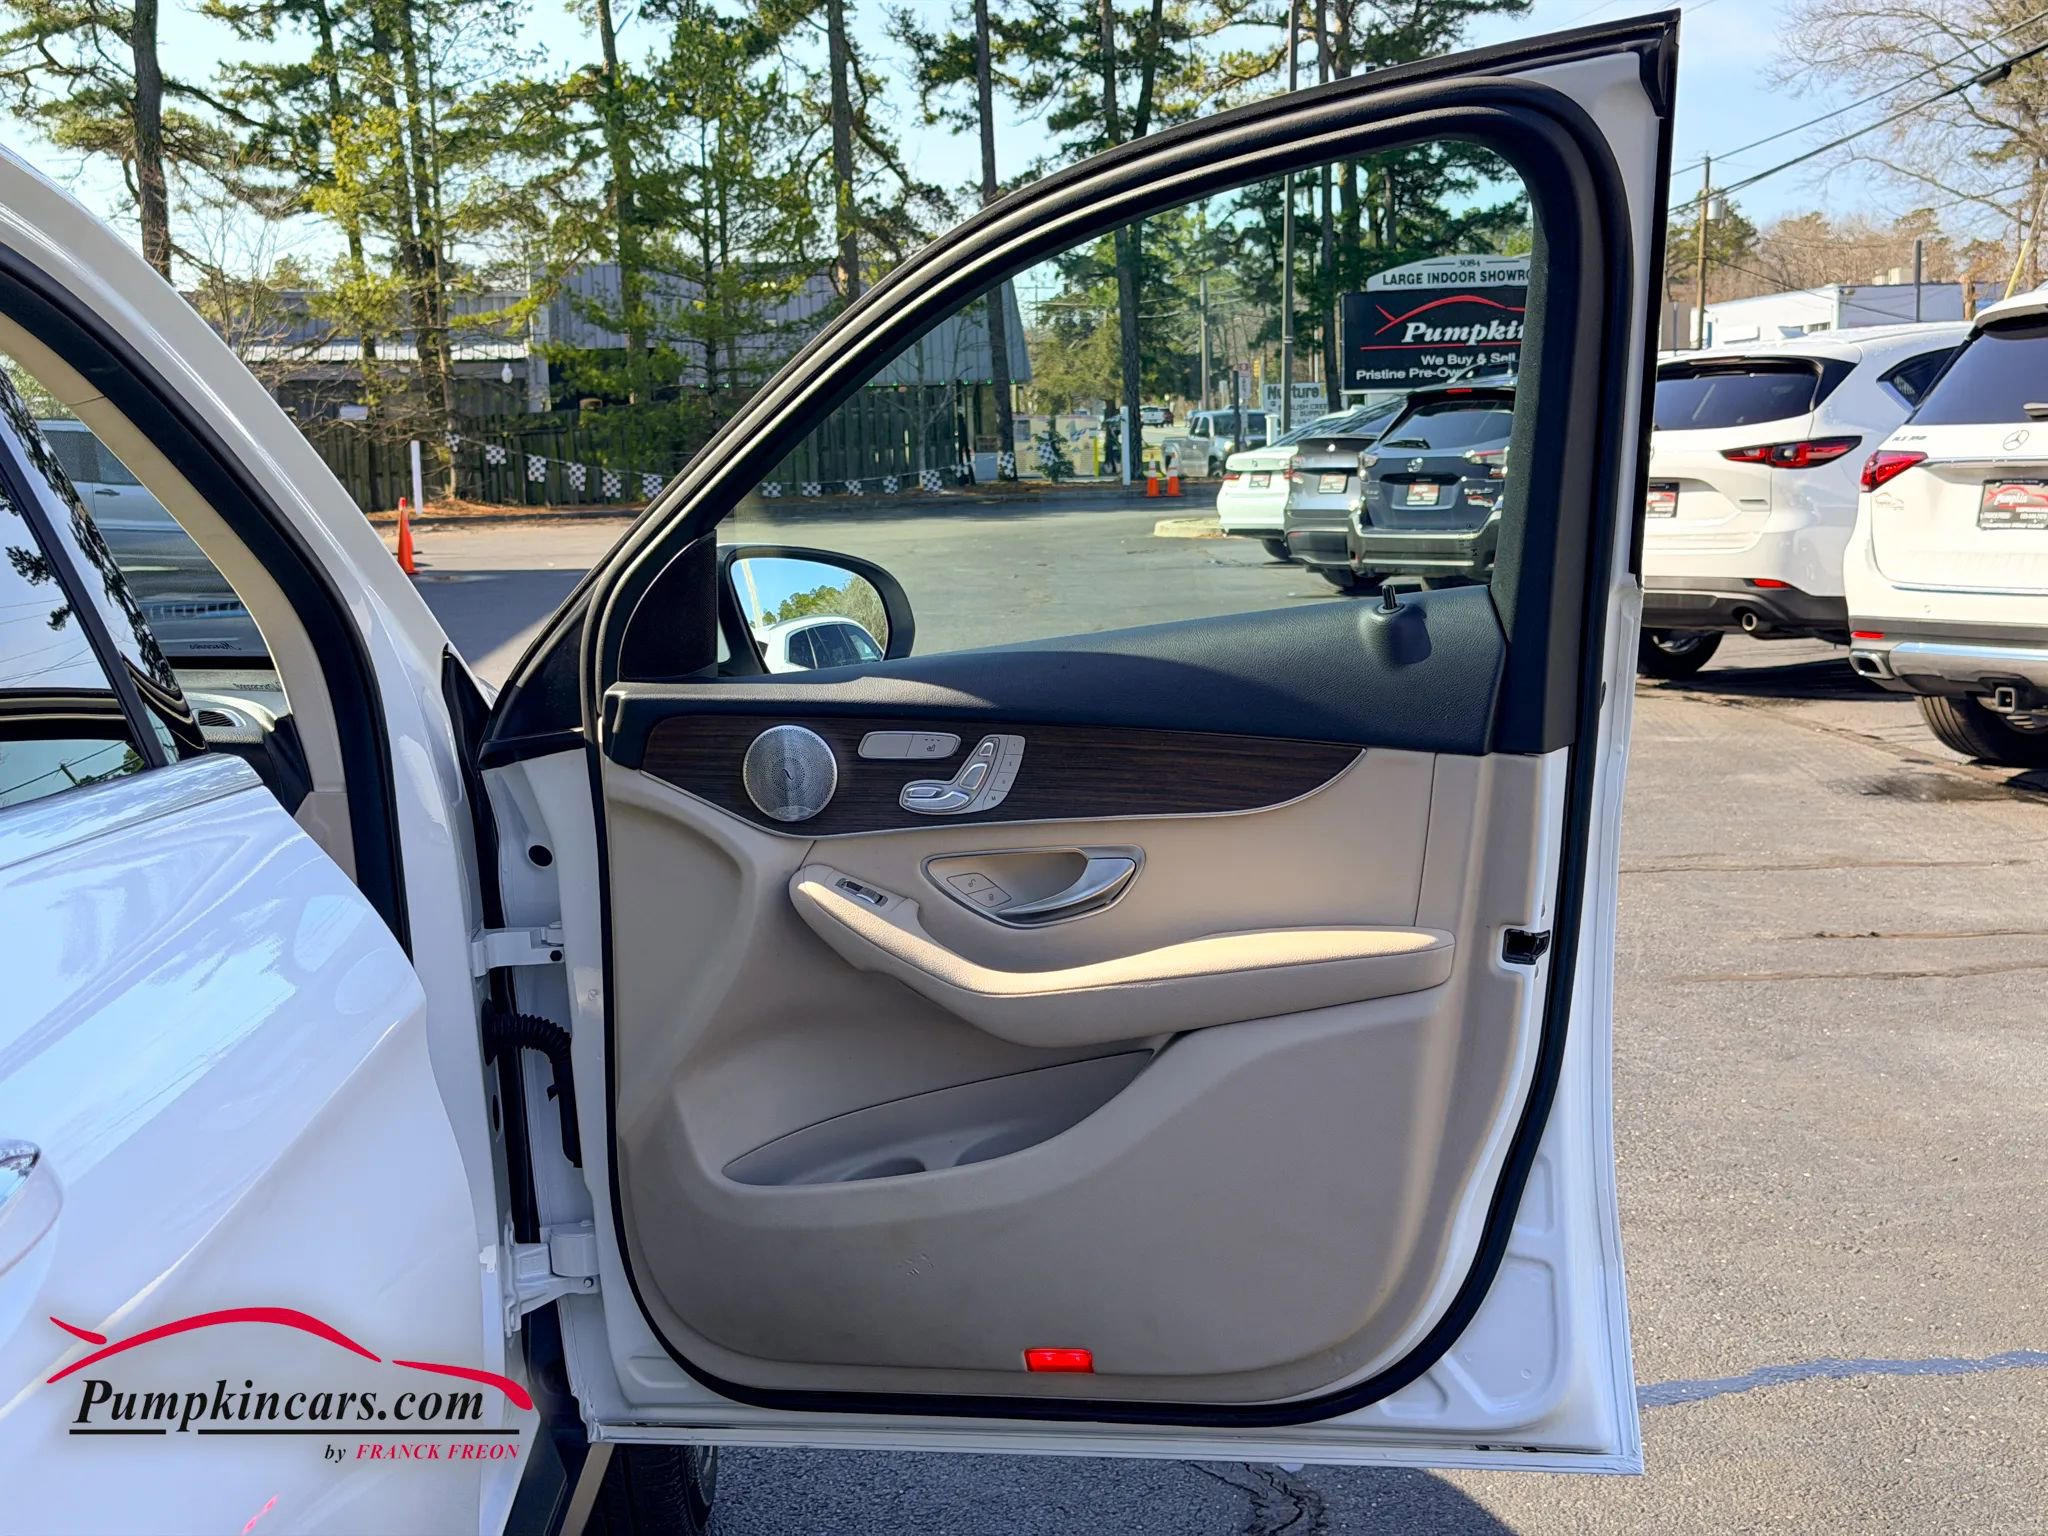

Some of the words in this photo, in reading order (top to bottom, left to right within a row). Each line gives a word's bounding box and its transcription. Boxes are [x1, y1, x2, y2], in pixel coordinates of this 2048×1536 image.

[1382, 273, 1423, 286] LARGE
[1427, 270, 1476, 284] INDOOR
[1420, 354, 1445, 366] We
[1447, 353, 1474, 367] Buy
[1476, 352, 1487, 366] &
[1490, 351, 1516, 363] Sell
[1355, 369, 1407, 381] Pristine
[1267, 386, 1319, 399] Nture
